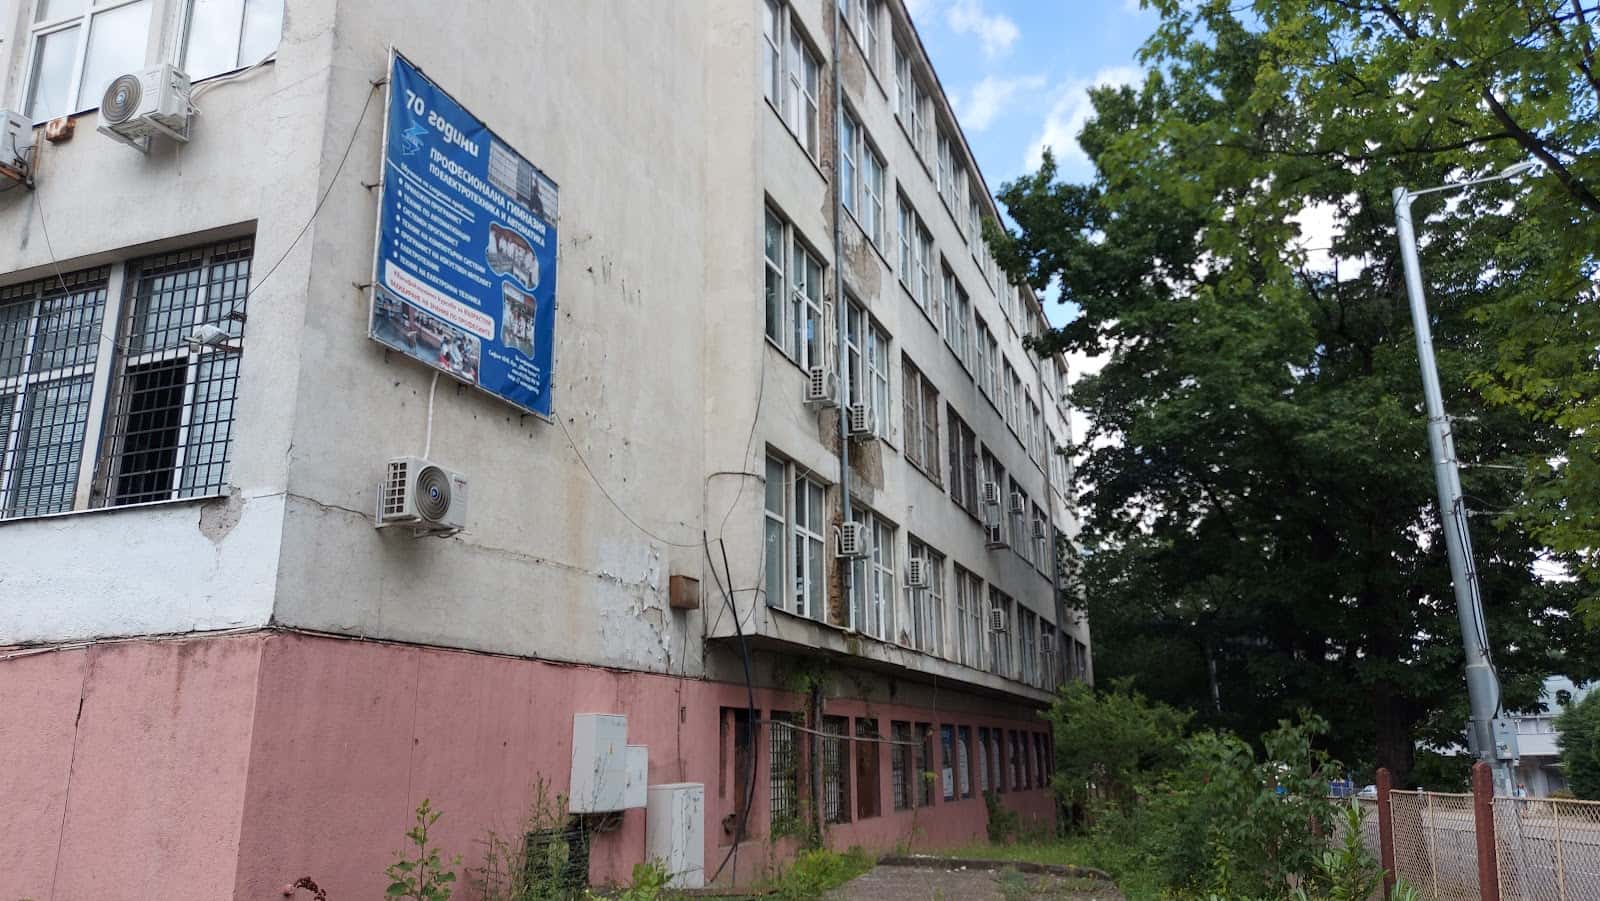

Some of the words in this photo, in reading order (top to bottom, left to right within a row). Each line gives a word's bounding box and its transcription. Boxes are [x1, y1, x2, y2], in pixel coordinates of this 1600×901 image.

[405, 88, 425, 118] 70
[428, 110, 479, 158] години
[430, 147, 505, 208] ПРОФЕСИОНАЛНА
[507, 201, 546, 235] ГИМНАЗИЯ
[501, 211, 506, 221] И
